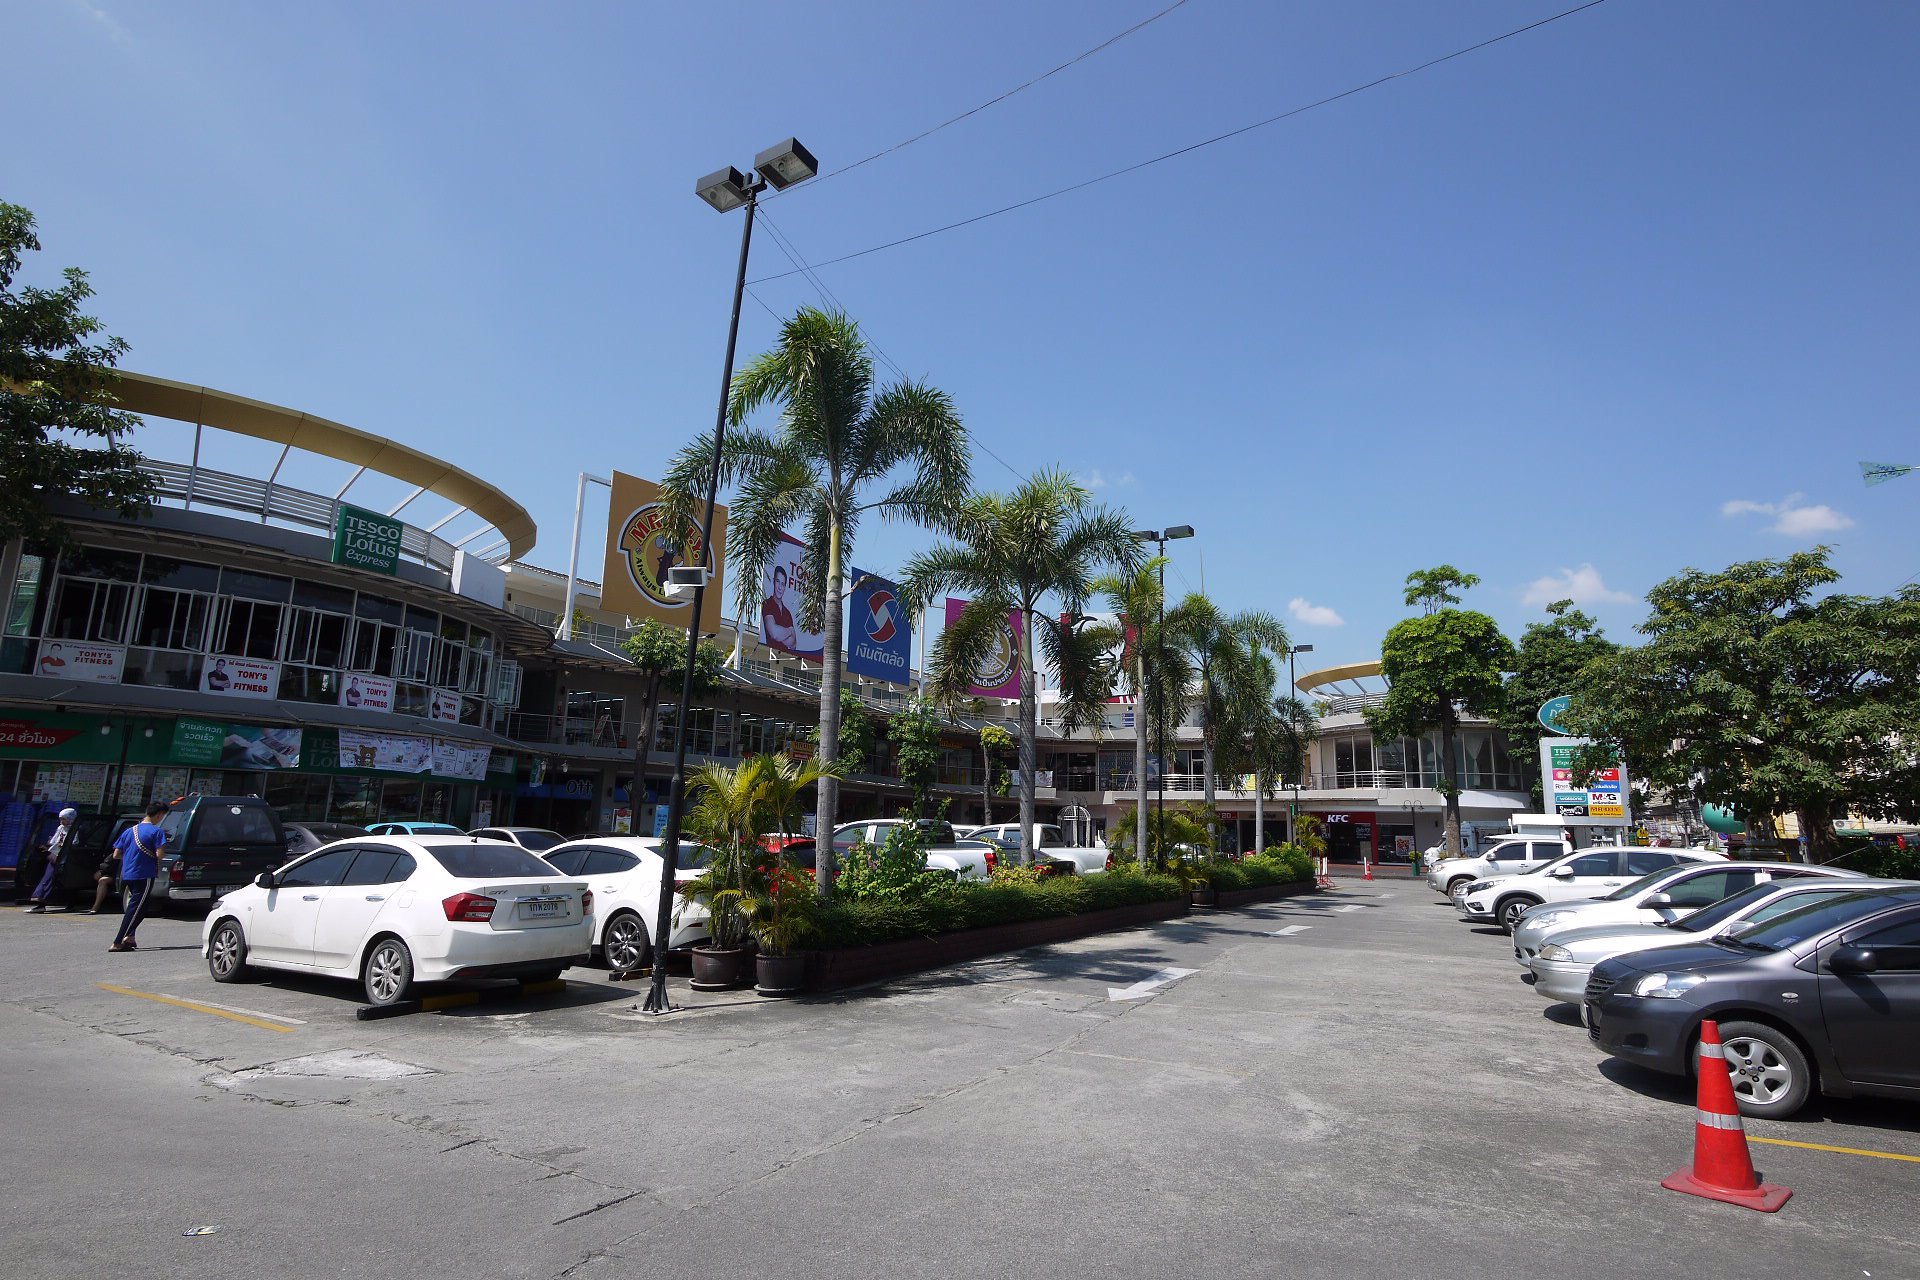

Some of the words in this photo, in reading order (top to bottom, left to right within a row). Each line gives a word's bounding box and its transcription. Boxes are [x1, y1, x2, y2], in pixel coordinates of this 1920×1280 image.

[346, 515, 400, 540] TESCO
[344, 532, 396, 558] Lotus
[345, 548, 391, 568] express
[79, 650, 112, 659] TONY'S
[855, 642, 905, 668] เงินติดล้อ
[74, 656, 113, 665] FITNESS
[237, 670, 267, 681] TONY'S
[233, 682, 269, 693] FITNESS
[366, 687, 387, 697] TONY'S
[363, 699, 388, 709] FITNESS
[0, 732, 15, 743] 24
[18, 729, 56, 745] ชั่วโมง
[1327, 814, 1349, 823] KFC
